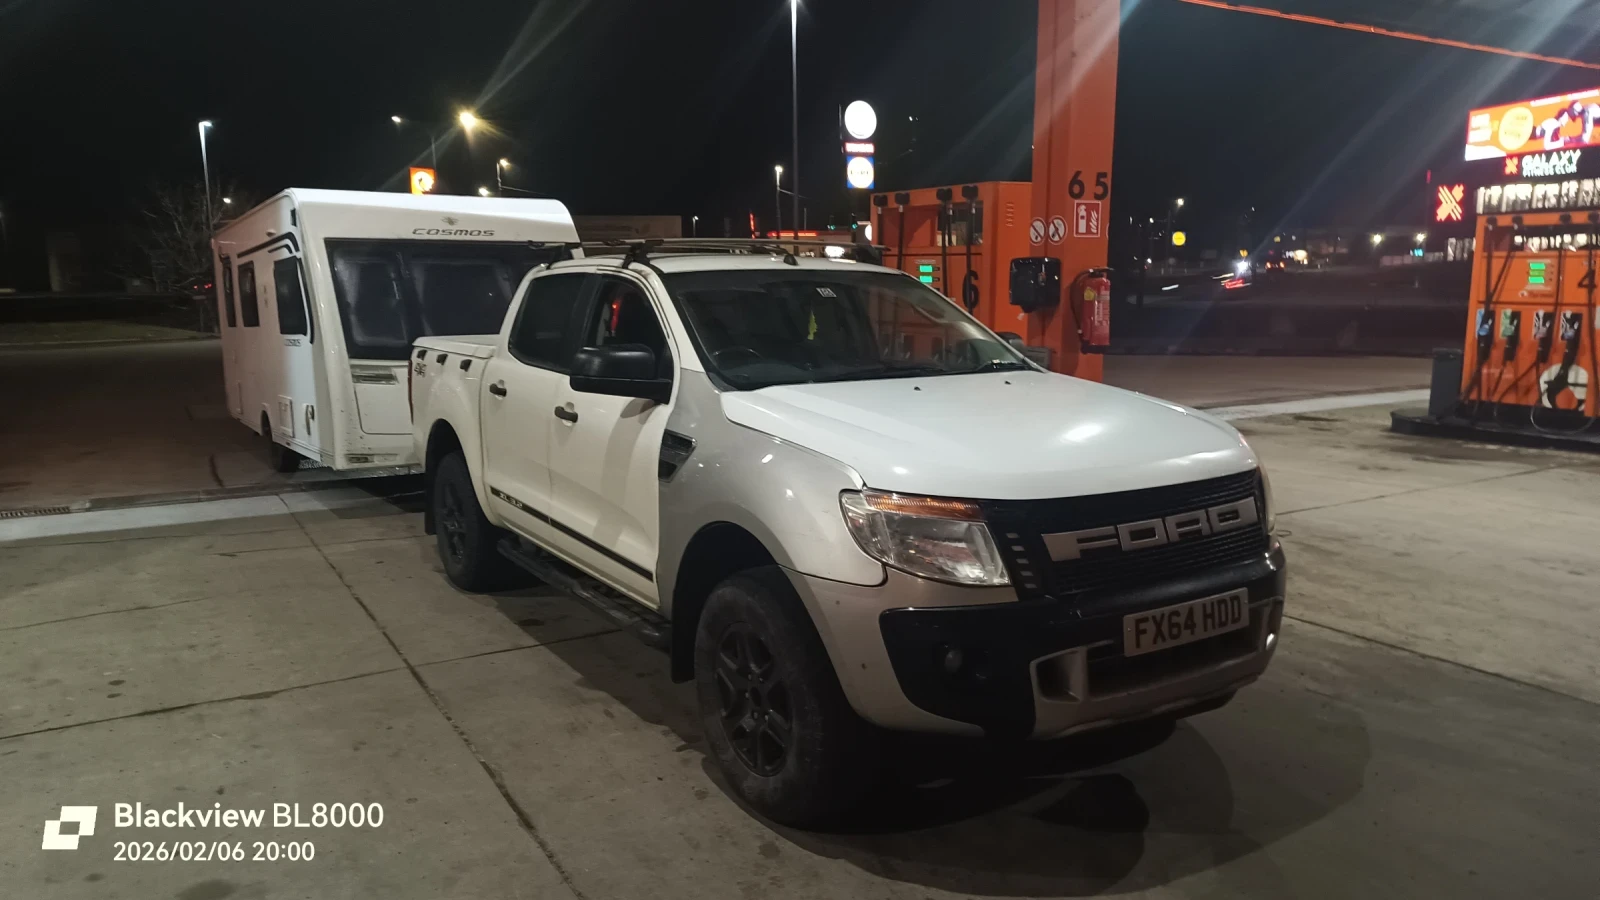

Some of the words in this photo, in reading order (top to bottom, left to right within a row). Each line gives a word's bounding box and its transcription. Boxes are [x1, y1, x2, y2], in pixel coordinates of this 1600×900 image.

[1522, 149, 1581, 168] GALAXY
[1068, 170, 1085, 199] 6
[1093, 172, 1109, 200] 5
[412, 228, 495, 237] COSMOS
[962, 270, 979, 309] 6
[1578, 268, 1597, 296] 4
[1041, 497, 1258, 562] FORD
[1134, 607, 1197, 649] FX64
[1201, 595, 1242, 632] HDD
